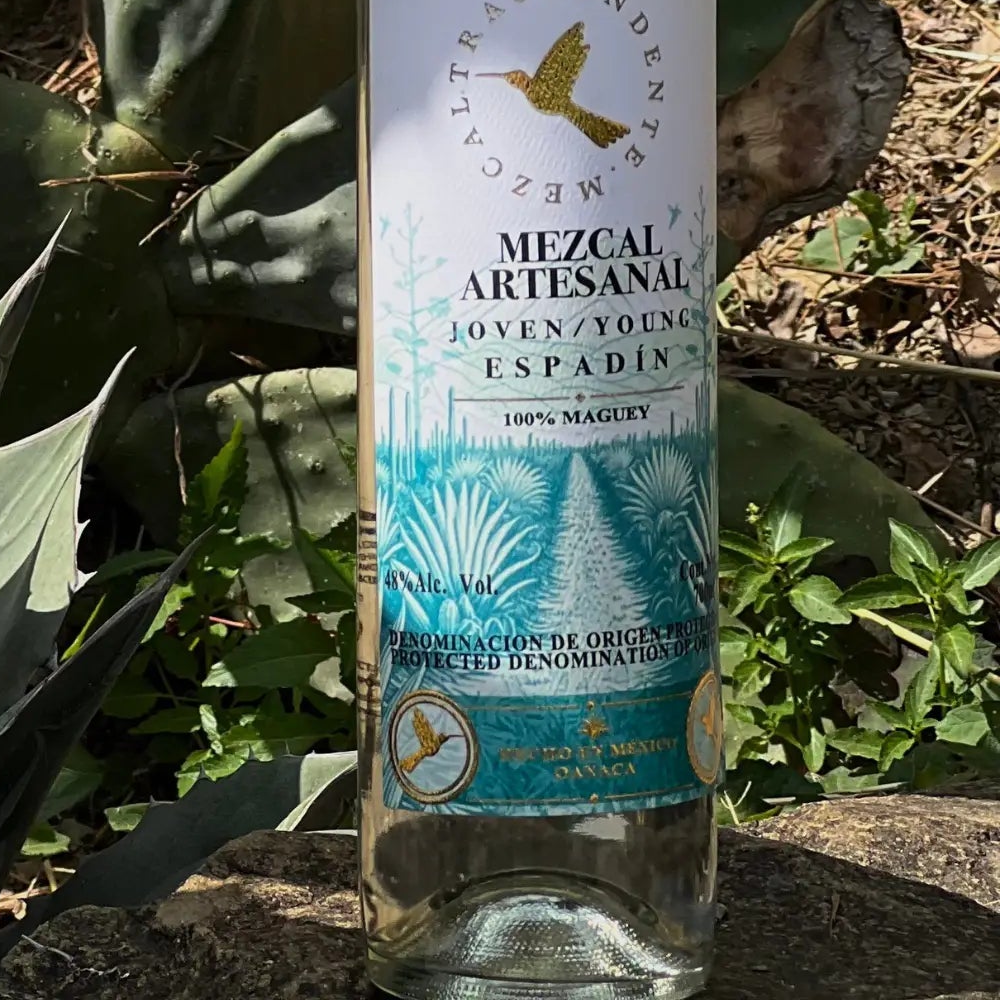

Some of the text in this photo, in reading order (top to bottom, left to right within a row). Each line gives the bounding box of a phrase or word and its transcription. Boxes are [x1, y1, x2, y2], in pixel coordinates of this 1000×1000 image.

[451, 96, 605, 205] MEZCAL
[496, 224, 663, 263] MEZCAL
[460, 258, 690, 301] ARTESANAL
[448, 307, 690, 343] JOVEN/YOUNG
[484, 344, 670, 380] ESPADÍN
[503, 404, 650, 427] 100% MAGUEY
[459, 573, 499, 596] Vol.
[388, 630, 542, 652] DENOMINACION
[551, 633, 579, 651] DE
[586, 624, 661, 649] ORIGEN
[390, 647, 501, 671] PROTECTED
[509, 643, 669, 671] DENOMINATION
[674, 637, 692, 658] OF
